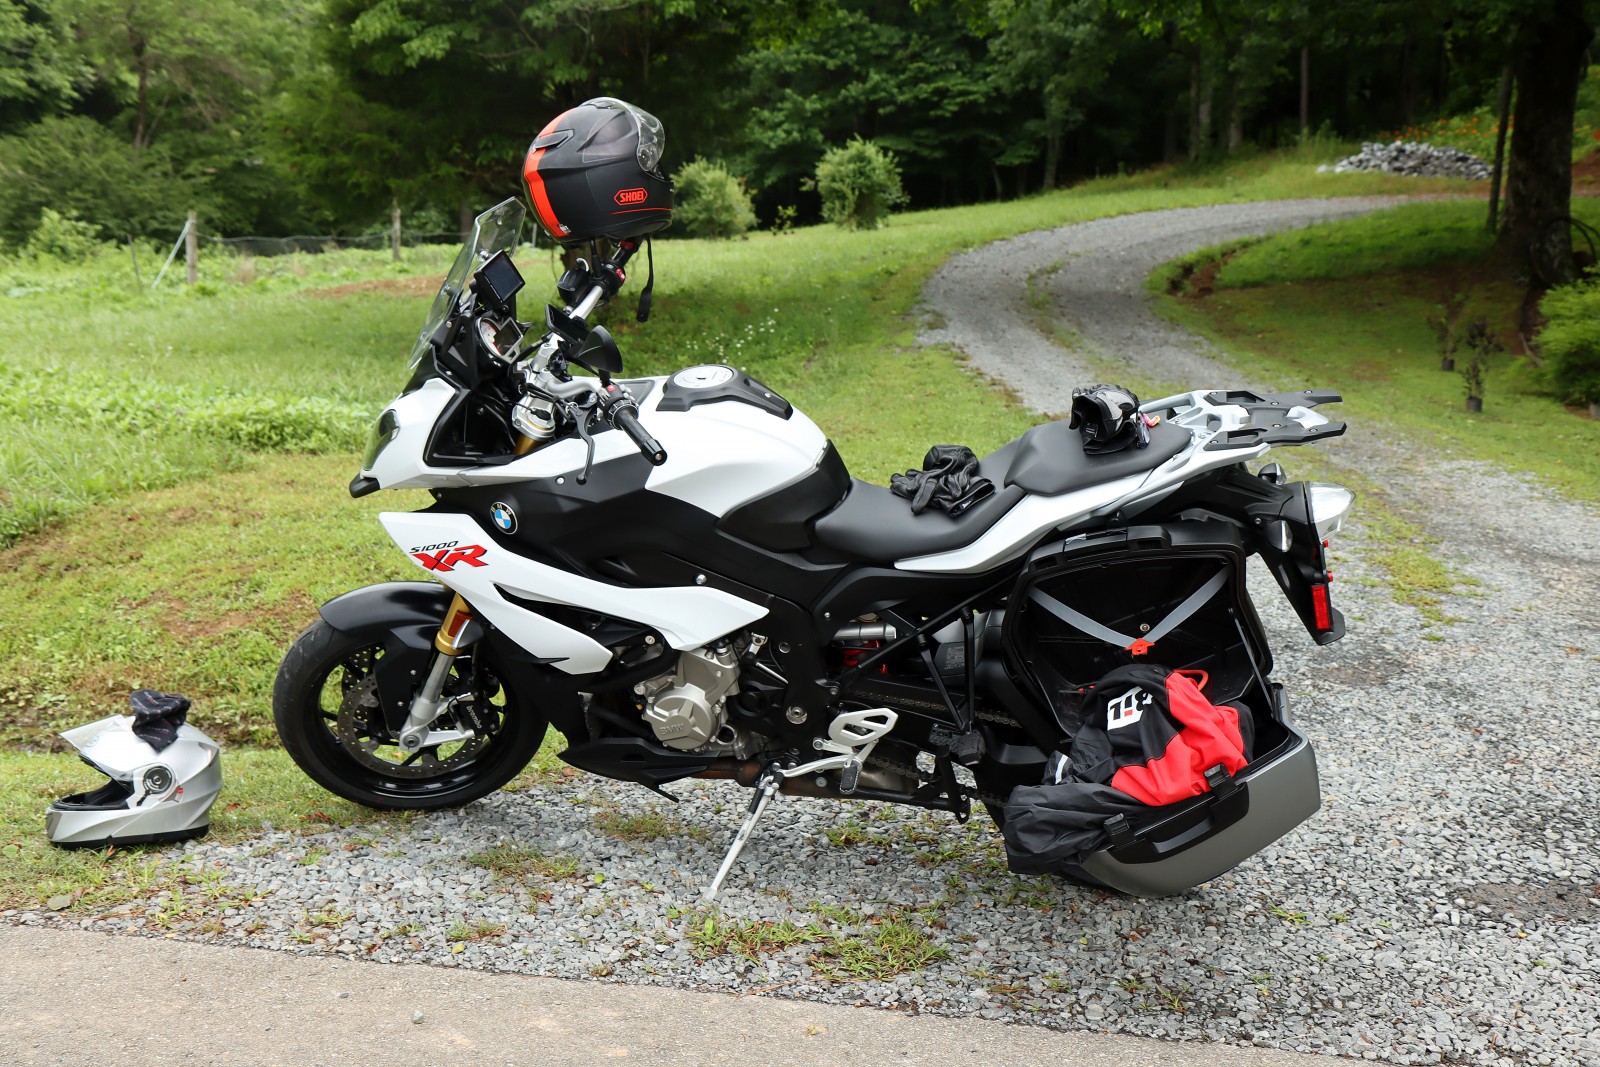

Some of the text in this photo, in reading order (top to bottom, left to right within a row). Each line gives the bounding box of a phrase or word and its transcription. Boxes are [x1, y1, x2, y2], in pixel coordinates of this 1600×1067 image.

[619, 190, 644, 203] SHOEI
[408, 540, 459, 554] S1000
[411, 544, 489, 572] XR
[466, 705, 482, 729] brembo
